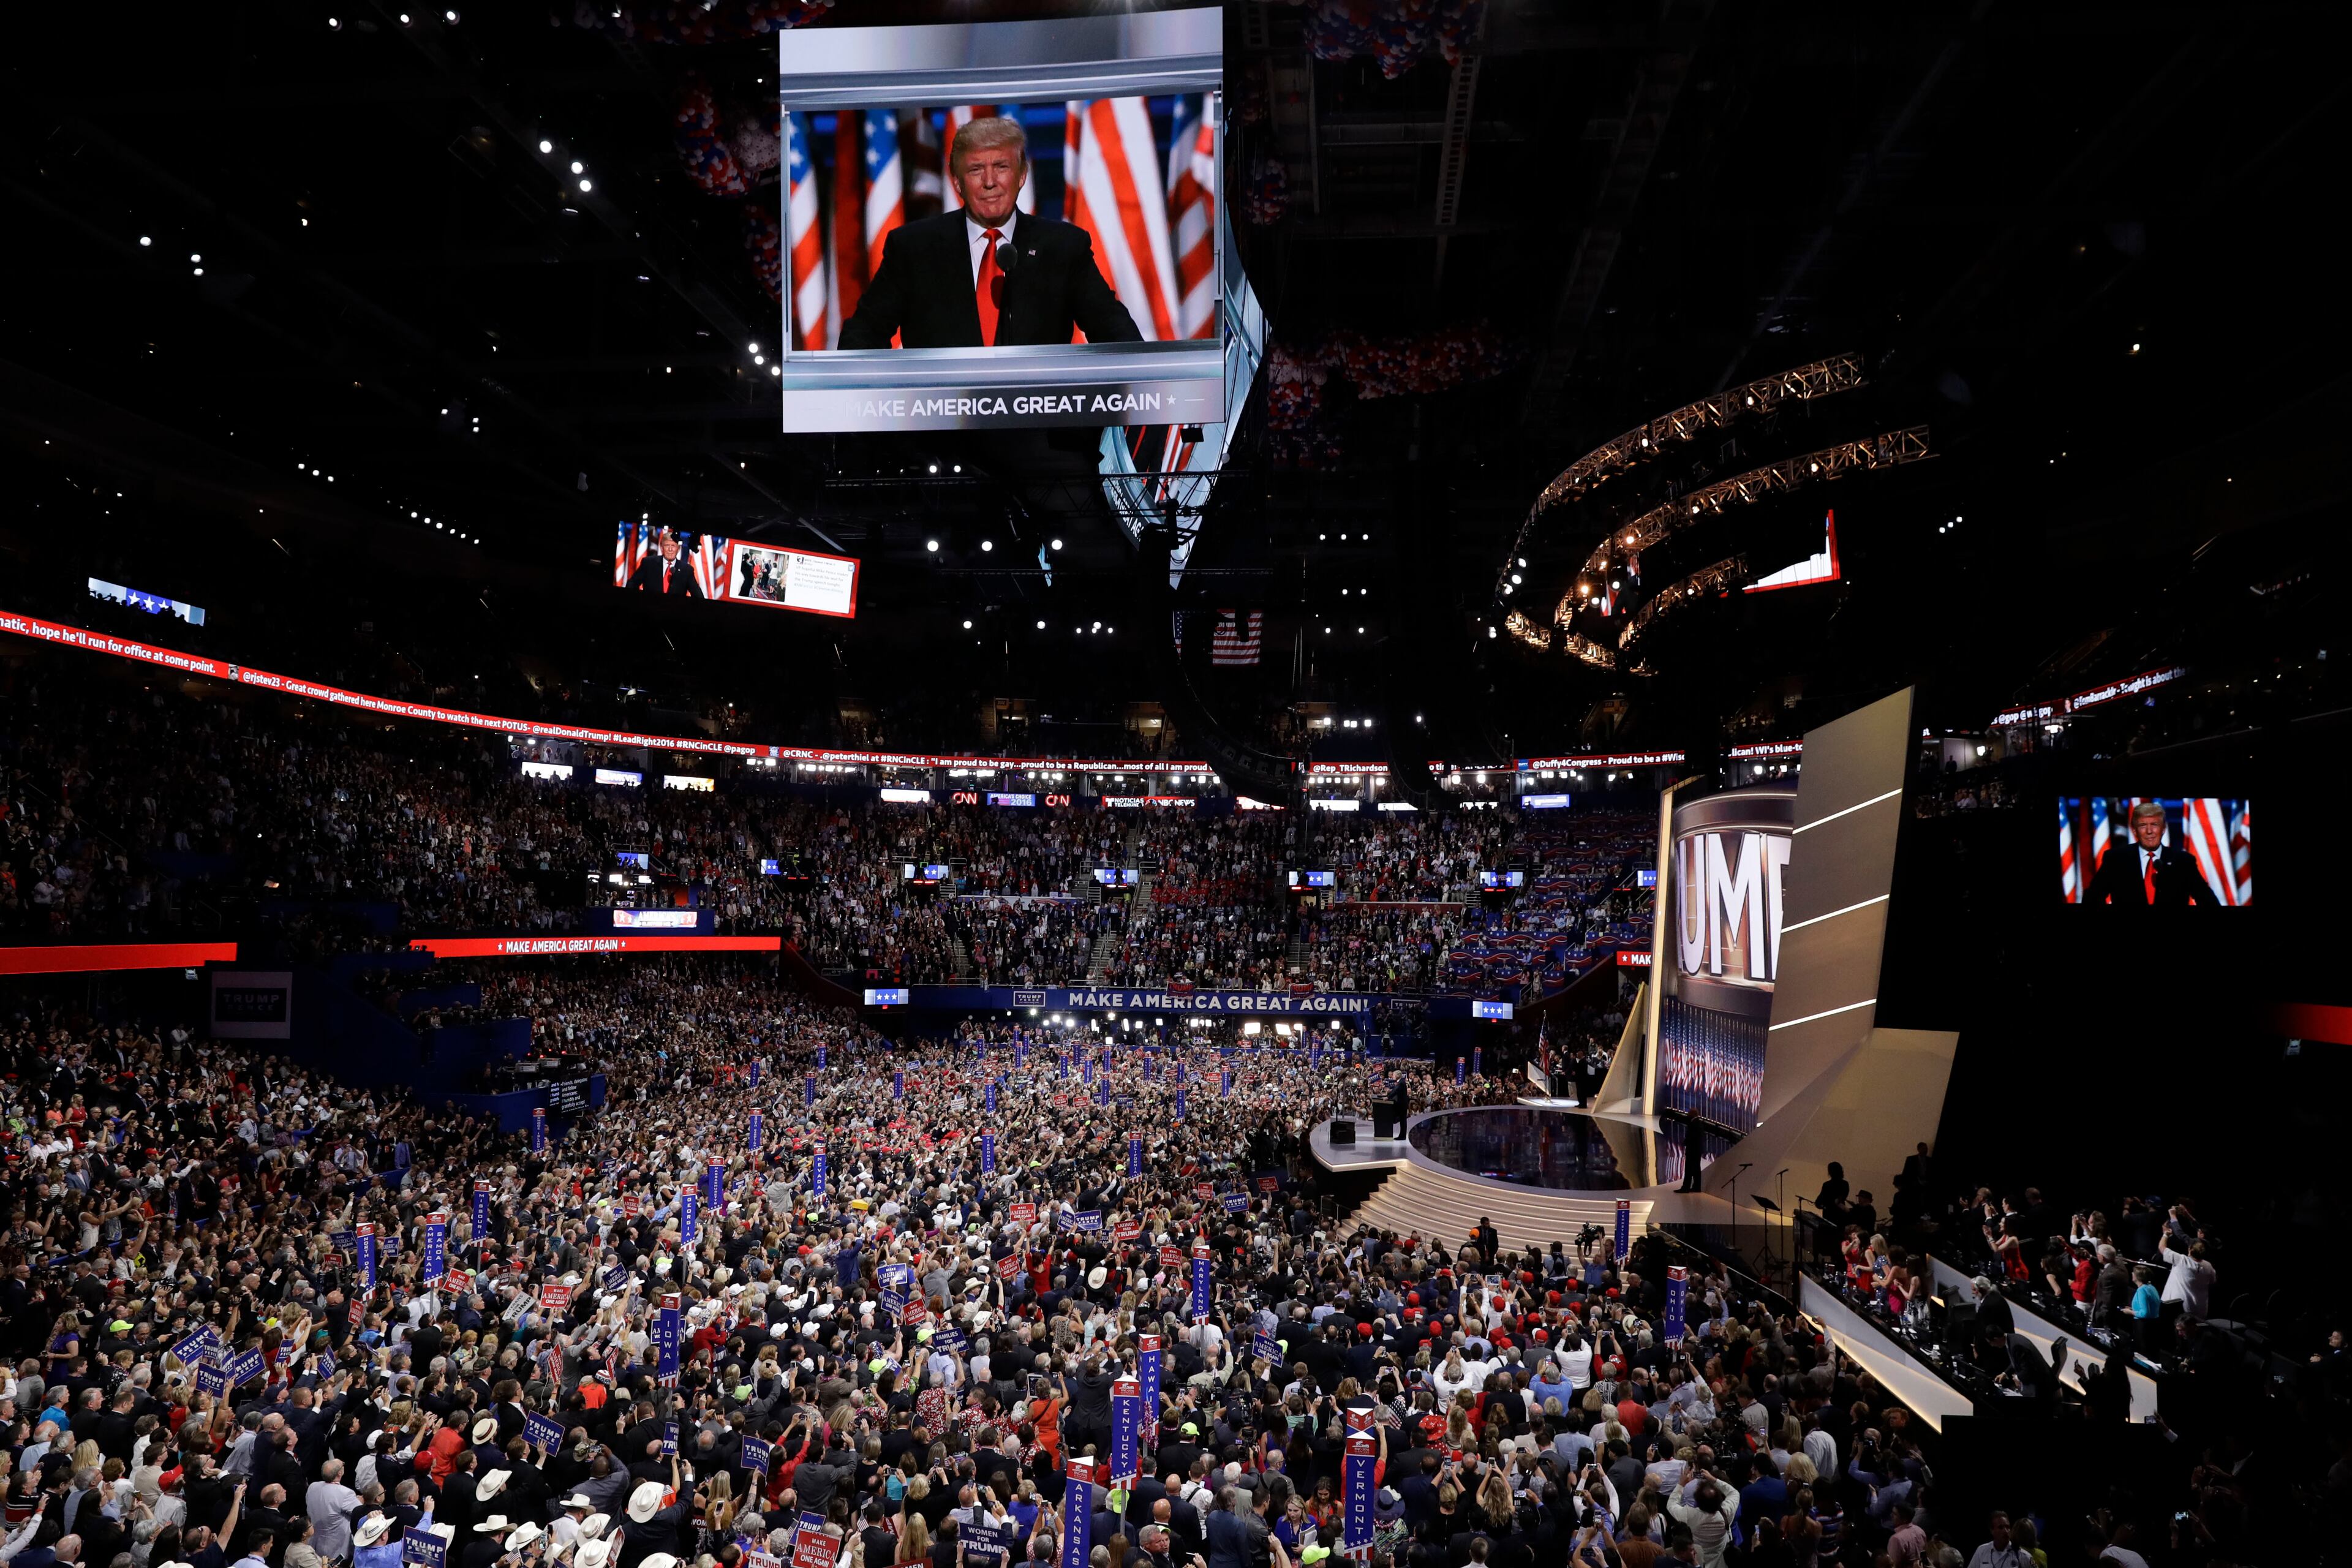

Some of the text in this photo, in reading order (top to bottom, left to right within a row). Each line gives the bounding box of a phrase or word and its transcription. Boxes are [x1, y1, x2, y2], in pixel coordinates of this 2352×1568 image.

[911, 397, 1008, 417] AMERICA
[1013, 395, 1086, 414] GREAT
[1090, 393, 1160, 412] AGAIN
[32, 622, 60, 640] hope
[62, 628, 86, 645] he'll
[88, 636, 105, 649] run
[108, 639, 123, 652] for
[124, 643, 151, 659] office
[153, 650, 164, 662] at
[165, 655, 189, 667] some
[190, 660, 216, 676] point.
[2152, 671, 2173, 684] about
[243, 671, 280, 688] @rjstev23
[286, 681, 306, 695] Great
[307, 686, 329, 699] crowd
[330, 690, 360, 706] gathered
[360, 694, 375, 707] here
[377, 697, 405, 713] Monroe
[407, 704, 435, 720] County
[437, 710, 446, 719] to
[447, 712, 470, 724] watch
[472, 715, 483, 725] the
[484, 717, 500, 729] next
[532, 725, 611, 741] @realDonaldTrump!
[613, 733, 674, 747] #LeadRight2016
[676, 740, 722, 751] #RNCinCLE
[723, 744, 755, 755] @pagop
[1732, 747, 1754, 757] lican!
[783, 749, 813, 759] @CRNC
[880, 756, 925, 766] #RNCinCLE
[954, 758, 978, 769] proud
[1056, 761, 1066, 769] be
[1144, 762, 1154, 771] of
[1155, 762, 1164, 771] all
[1183, 763, 1207, 773] proud
[1532, 758, 1601, 769] @Duffy4Congress
[1608, 756, 1632, 766] Proud
[1644, 755, 1654, 764] be
[1313, 765, 1388, 774] @Rep_TRichardson
[953, 793, 976, 804] CNN
[506, 939, 618, 953] MAKE AMERICA GREAT AGAIN
[1631, 954, 1651, 965] MAK
[224, 994, 279, 1003] TRUMP
[1069, 993, 1368, 1012] MAKE AMERICA GREAT AGAIN!
[1117, 1229, 1140, 1238] TRUMP
[878, 1271, 907, 1281] AMERICA
[511, 1296, 532, 1318] RUMP
[904, 1305, 926, 1319] AMERICA
[177, 1330, 209, 1355] TRUMP
[664, 1320, 673, 1360] IOWA
[935, 1331, 959, 1341] FAMILIES
[204, 1345, 219, 1354] TRUMP
[1254, 1340, 1282, 1358] AMERICA
[1264, 1339, 1275, 1348] MAKE
[235, 1353, 260, 1372] RUMP
[324, 1352, 336, 1369] TRUMP
[195, 1370, 224, 1384] TRUMP
[200, 1376, 221, 1389] PENCE
[529, 1419, 560, 1439] TRUMP
[529, 1427, 556, 1444] PENCE
[1121, 1400, 1131, 1469] KENTUCKY
[745, 1444, 769, 1459] TRUMP
[747, 1452, 767, 1463] PENCE
[1355, 1459, 1365, 1535] VERMONT
[799, 1520, 822, 1531] TRUMP
[1072, 1483, 1084, 1566] ARKANSAS
[968, 1526, 998, 1539] WOMEN
[405, 1536, 443, 1554] TRUMP
[812, 1537, 827, 1547] MAKE
[960, 1539, 1007, 1555] TRUMP
[407, 1545, 440, 1559] PENCE
[796, 1543, 836, 1562] AMERICA
[750, 1556, 780, 1568] TRUMP
[800, 1554, 830, 1567] ONE AGAIN
